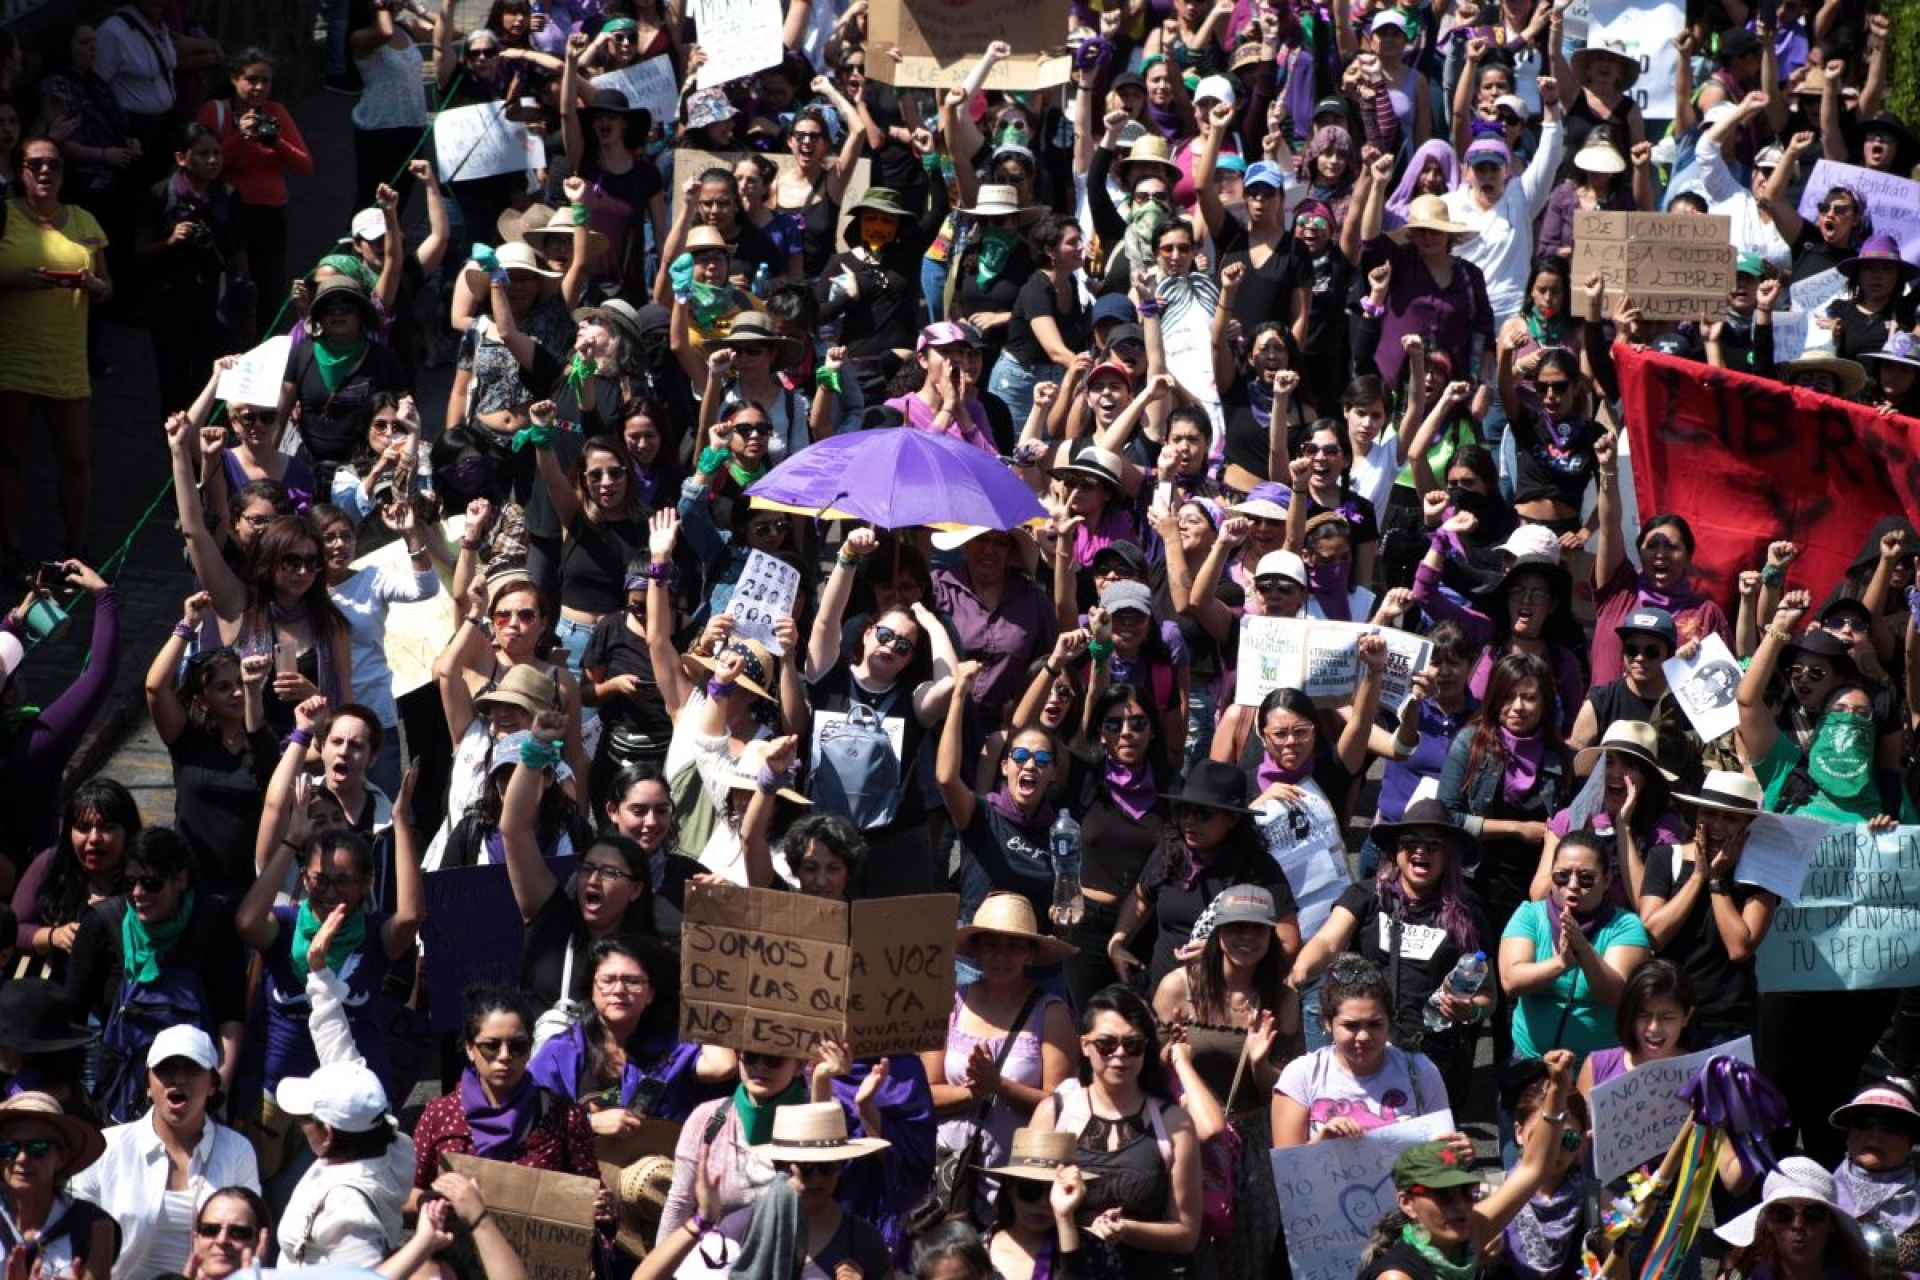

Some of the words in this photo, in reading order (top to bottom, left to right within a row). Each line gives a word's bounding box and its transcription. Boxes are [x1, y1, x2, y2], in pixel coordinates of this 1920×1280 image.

[1584, 215, 1613, 234] DE
[1584, 242, 1592, 257] A
[1602, 243, 1654, 262] CASA
[1667, 246, 1732, 264] QUIERO
[1600, 267, 1639, 284] SER
[1650, 269, 1727, 288] LIBRE
[1810, 832, 1882, 870] UENTRA
[1810, 871, 1905, 901] GUERRERA
[1774, 906, 1811, 932] QUE
[691, 922, 807, 969] SOMOS
[824, 950, 867, 982] LA
[884, 944, 945, 981] VOZ
[1791, 940, 1816, 973] TU
[1830, 935, 1909, 971] PECHO
[691, 964, 735, 993] DE
[749, 974, 799, 1002] LAS
[810, 987, 865, 1014] QUE
[881, 987, 923, 1015] YA
[686, 1006, 732, 1034] NO
[1610, 1078, 1639, 1108] NO
[1283, 1179, 1313, 1199] YO
[1332, 1163, 1367, 1184] NO
